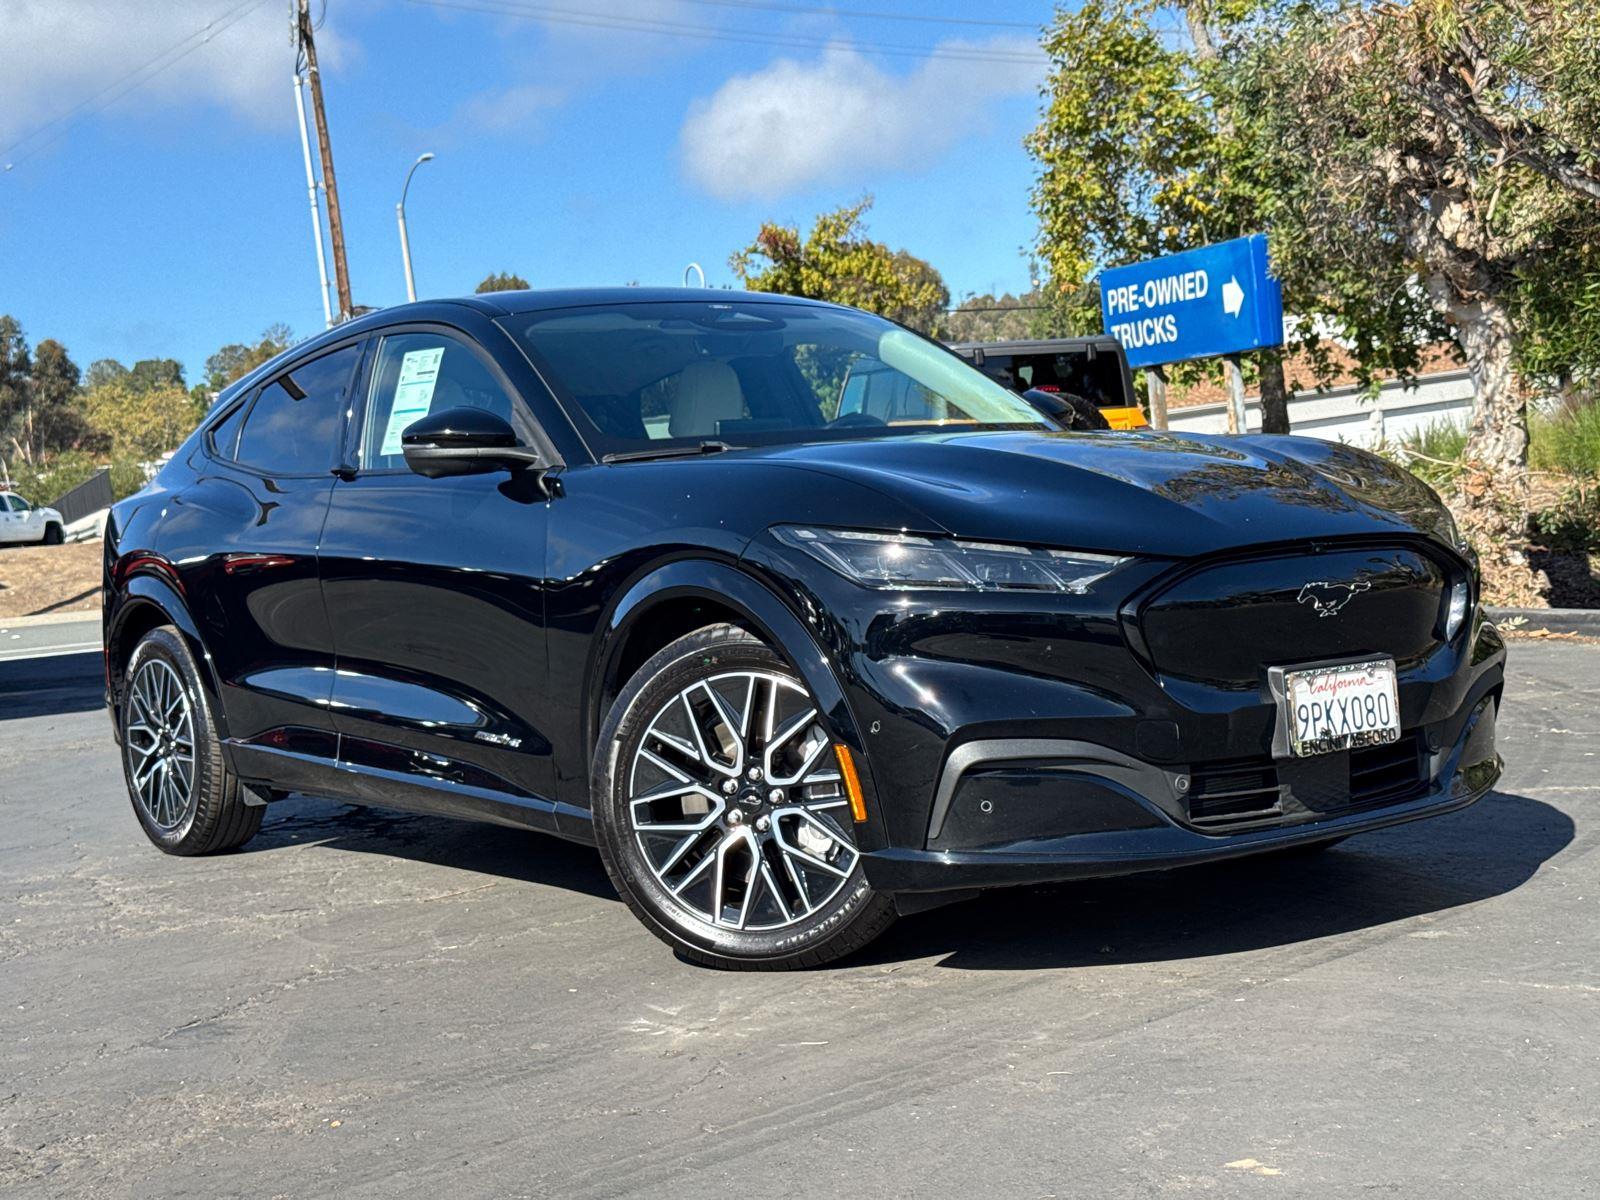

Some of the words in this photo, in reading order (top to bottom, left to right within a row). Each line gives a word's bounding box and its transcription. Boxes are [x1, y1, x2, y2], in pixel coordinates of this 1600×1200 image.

[1107, 270, 1208, 316] PRE-OWNED
[1110, 314, 1178, 350] TRUCKS
[1310, 673, 1374, 696] California
[1298, 692, 1390, 739] 9PKX080
